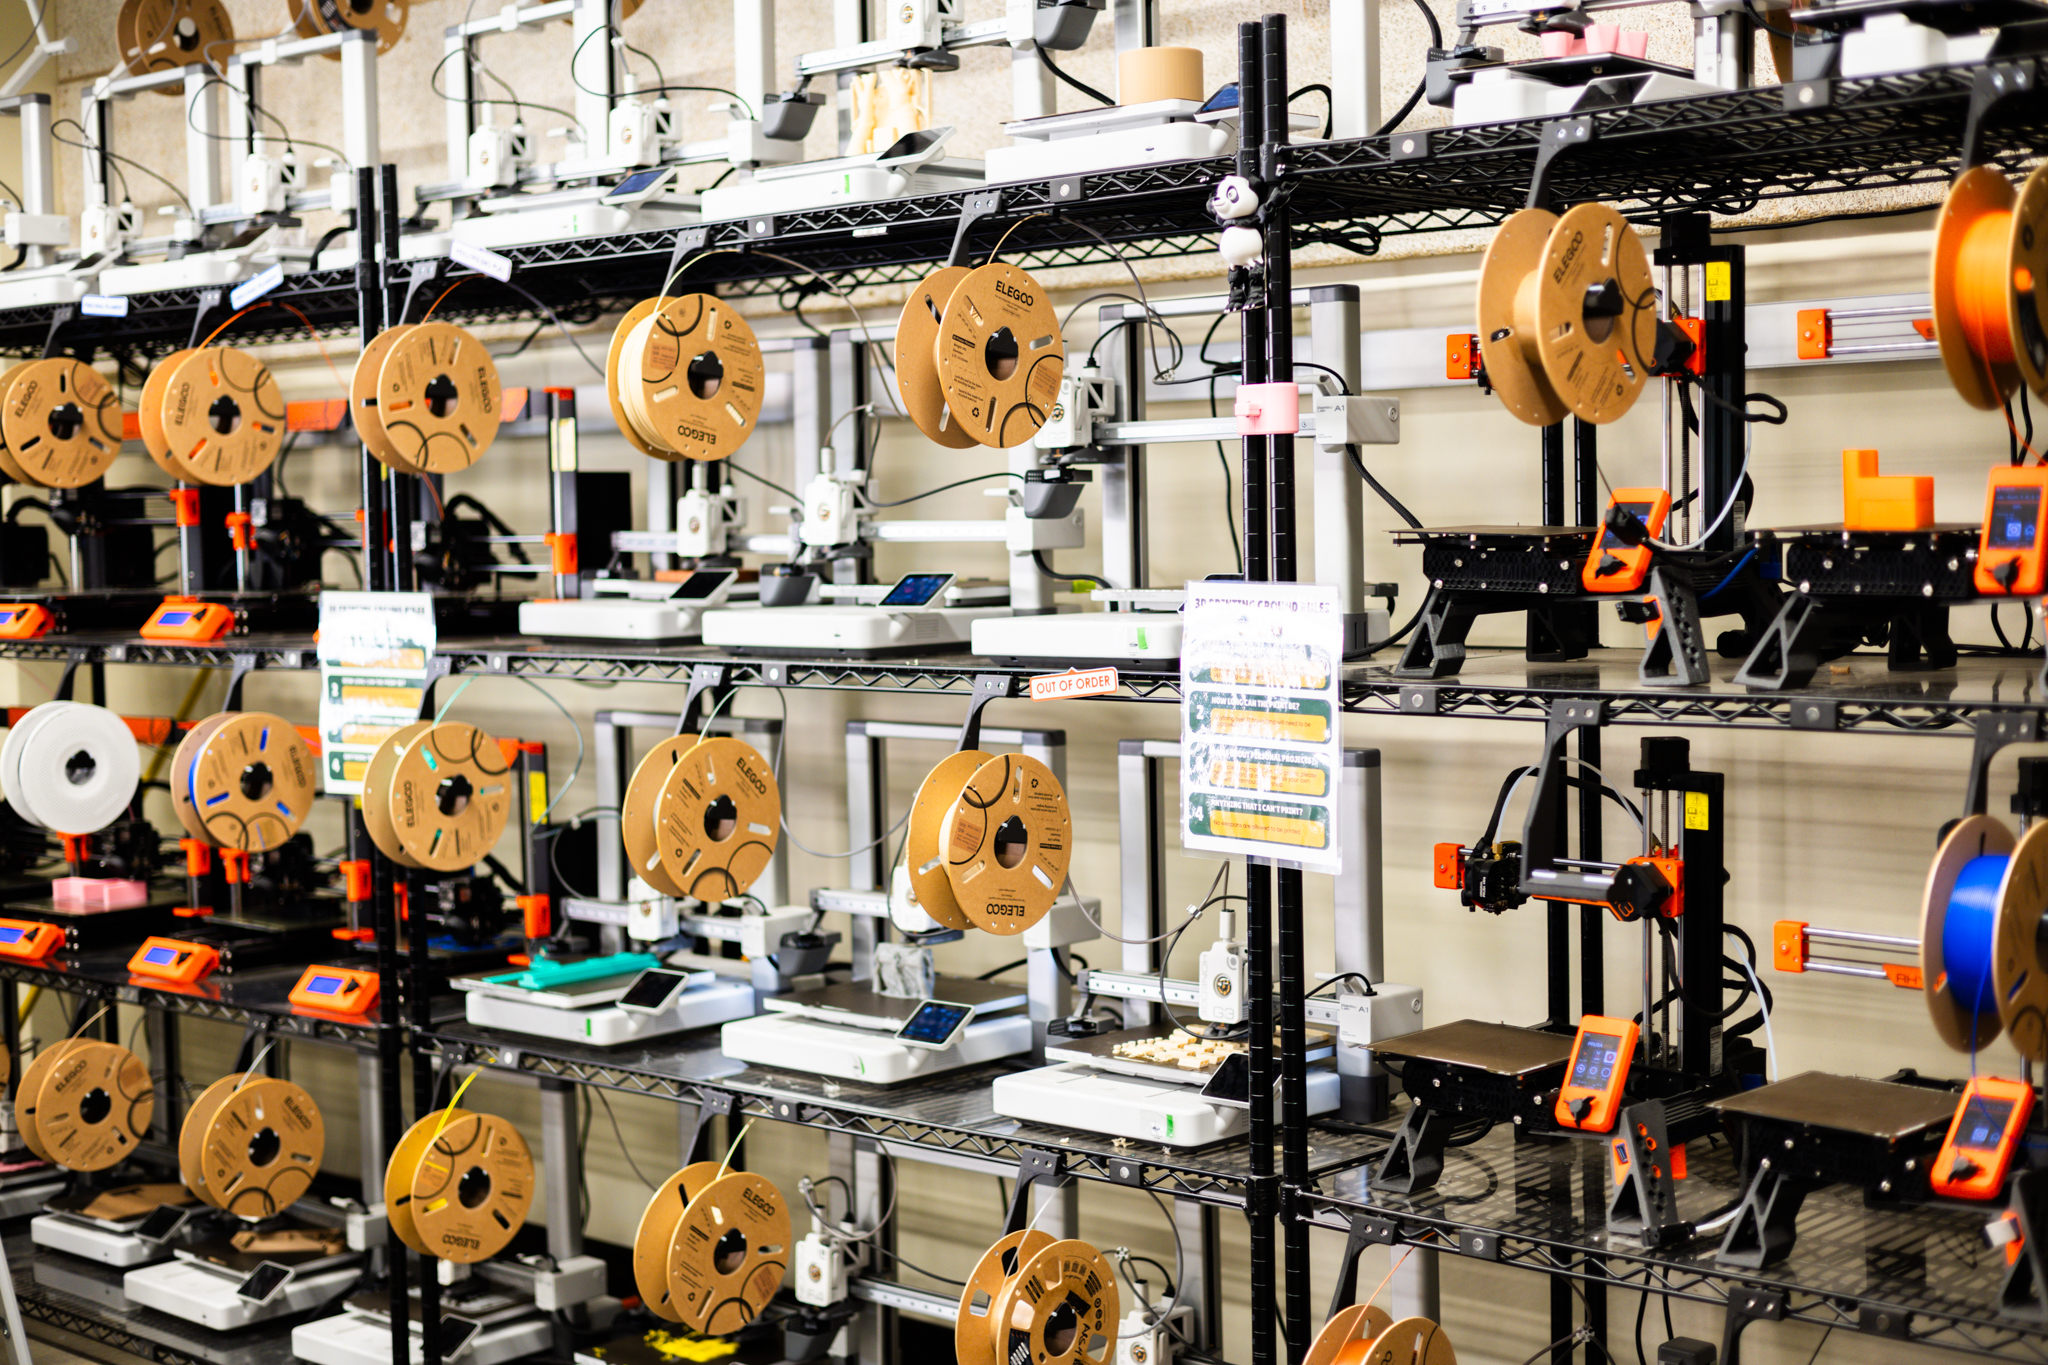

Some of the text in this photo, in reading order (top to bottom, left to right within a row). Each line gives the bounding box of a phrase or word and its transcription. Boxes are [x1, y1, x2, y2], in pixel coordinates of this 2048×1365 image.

[1552, 229, 1584, 285] ELEGOO
[995, 280, 1034, 306] ELEGOO
[14, 379, 38, 418] ELEGOO
[477, 366, 492, 414] ELEGOO
[174, 381, 190, 426] ELEGOO
[678, 425, 717, 445] ELEGOO
[1036, 675, 1111, 694] OUT OF ORDER
[1196, 705, 1204, 720] 2
[1212, 697, 1226, 705] HOW
[1258, 700, 1268, 708] THE
[1289, 702, 1300, 710] BE?
[288, 744, 307, 789] ELEGOO
[1250, 751, 1281, 760] PERSONAL
[736, 757, 767, 795] ELEGOO
[403, 779, 416, 829] ELEGOO
[1195, 806, 1204, 821] 4
[1211, 799, 1242, 809] ANYTHING
[1242, 802, 1258, 811] THAT
[1262, 804, 1280, 813] CAN'T
[1281, 806, 1303, 815] PRINT?
[1221, 821, 1242, 829] weapons
[1252, 823, 1270, 831] allowed
[986, 903, 1025, 917] ELEGOO
[1213, 1006, 1235, 1020] G3
[54, 1059, 88, 1094] ELEGOO
[284, 1094, 312, 1130] ELEGOO
[742, 1187, 776, 1217] ELEGOO
[442, 1233, 481, 1250] ELEGOO
